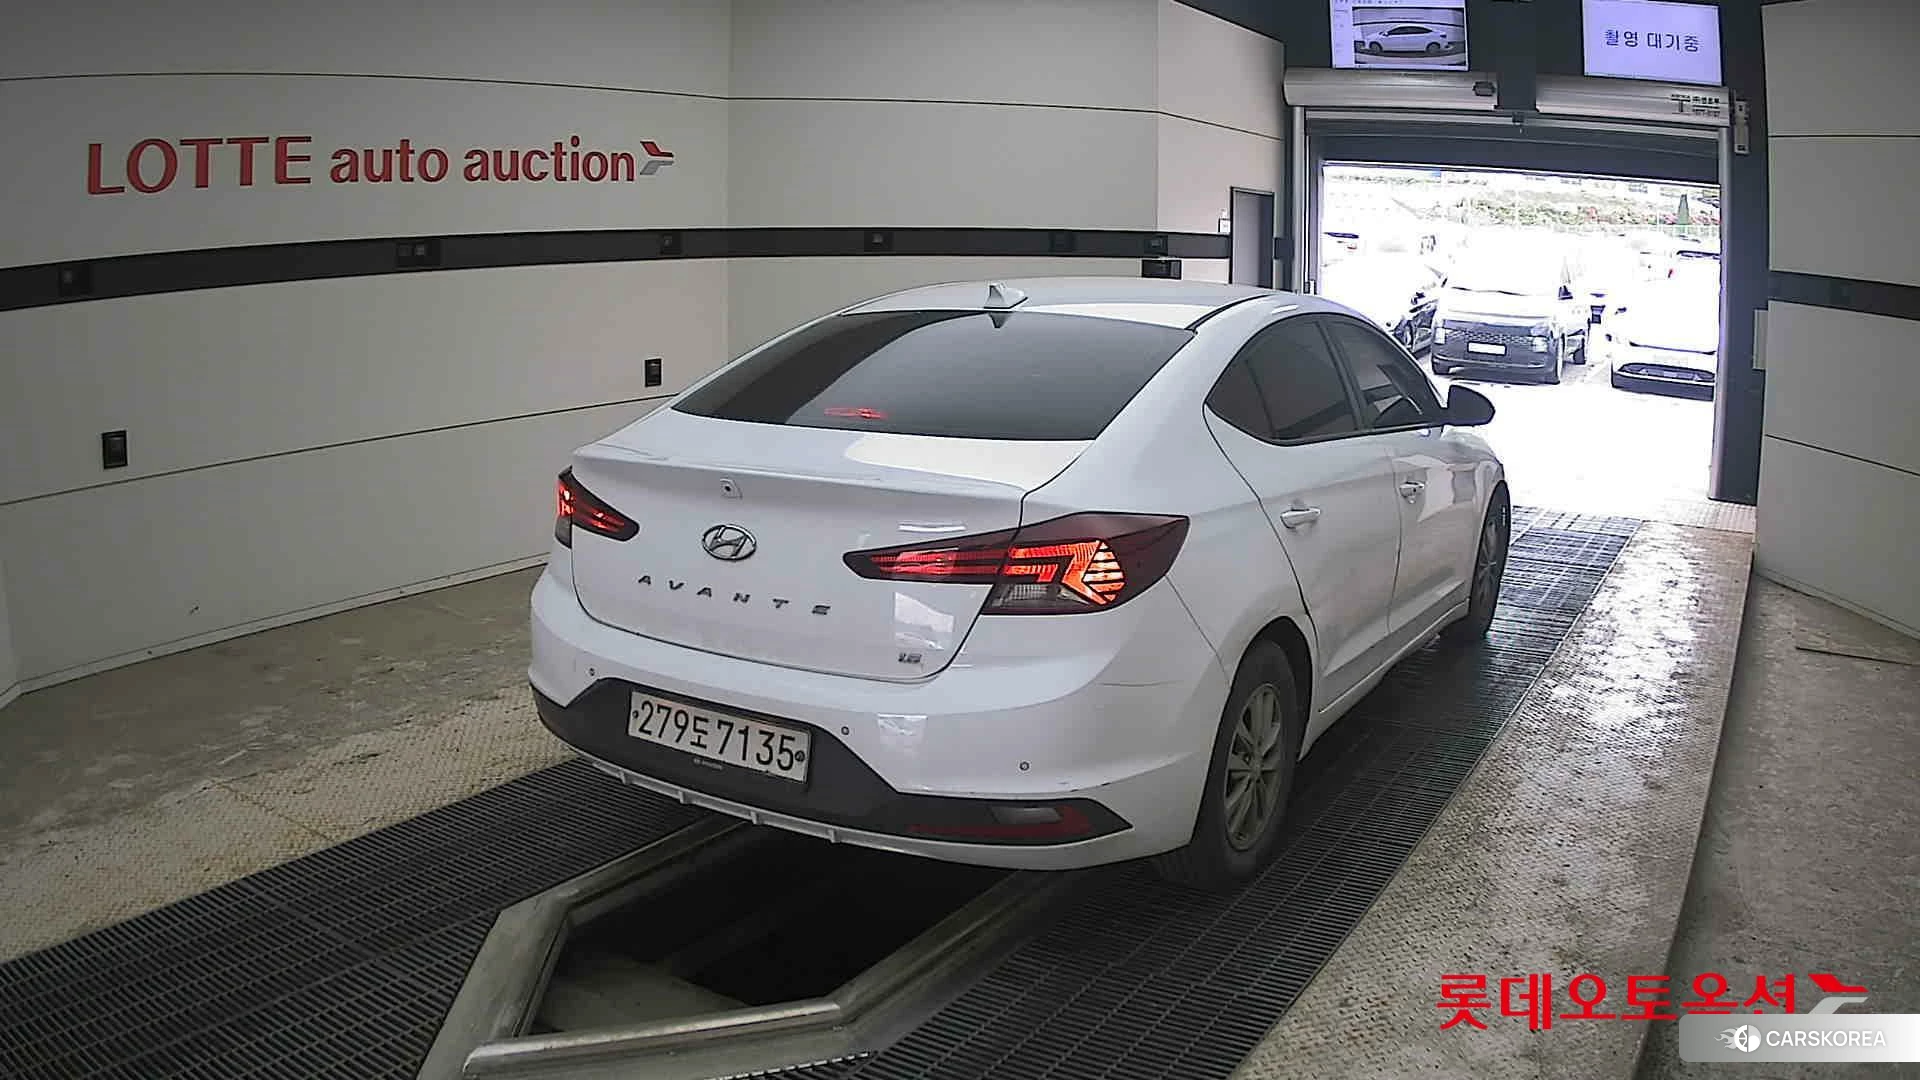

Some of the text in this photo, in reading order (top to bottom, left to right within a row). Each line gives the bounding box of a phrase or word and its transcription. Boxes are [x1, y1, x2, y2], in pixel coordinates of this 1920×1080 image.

[1647, 32, 1699, 52] 대기중
[86, 134, 636, 196] LOTTE auto auction
[637, 574, 832, 617] AVANTE
